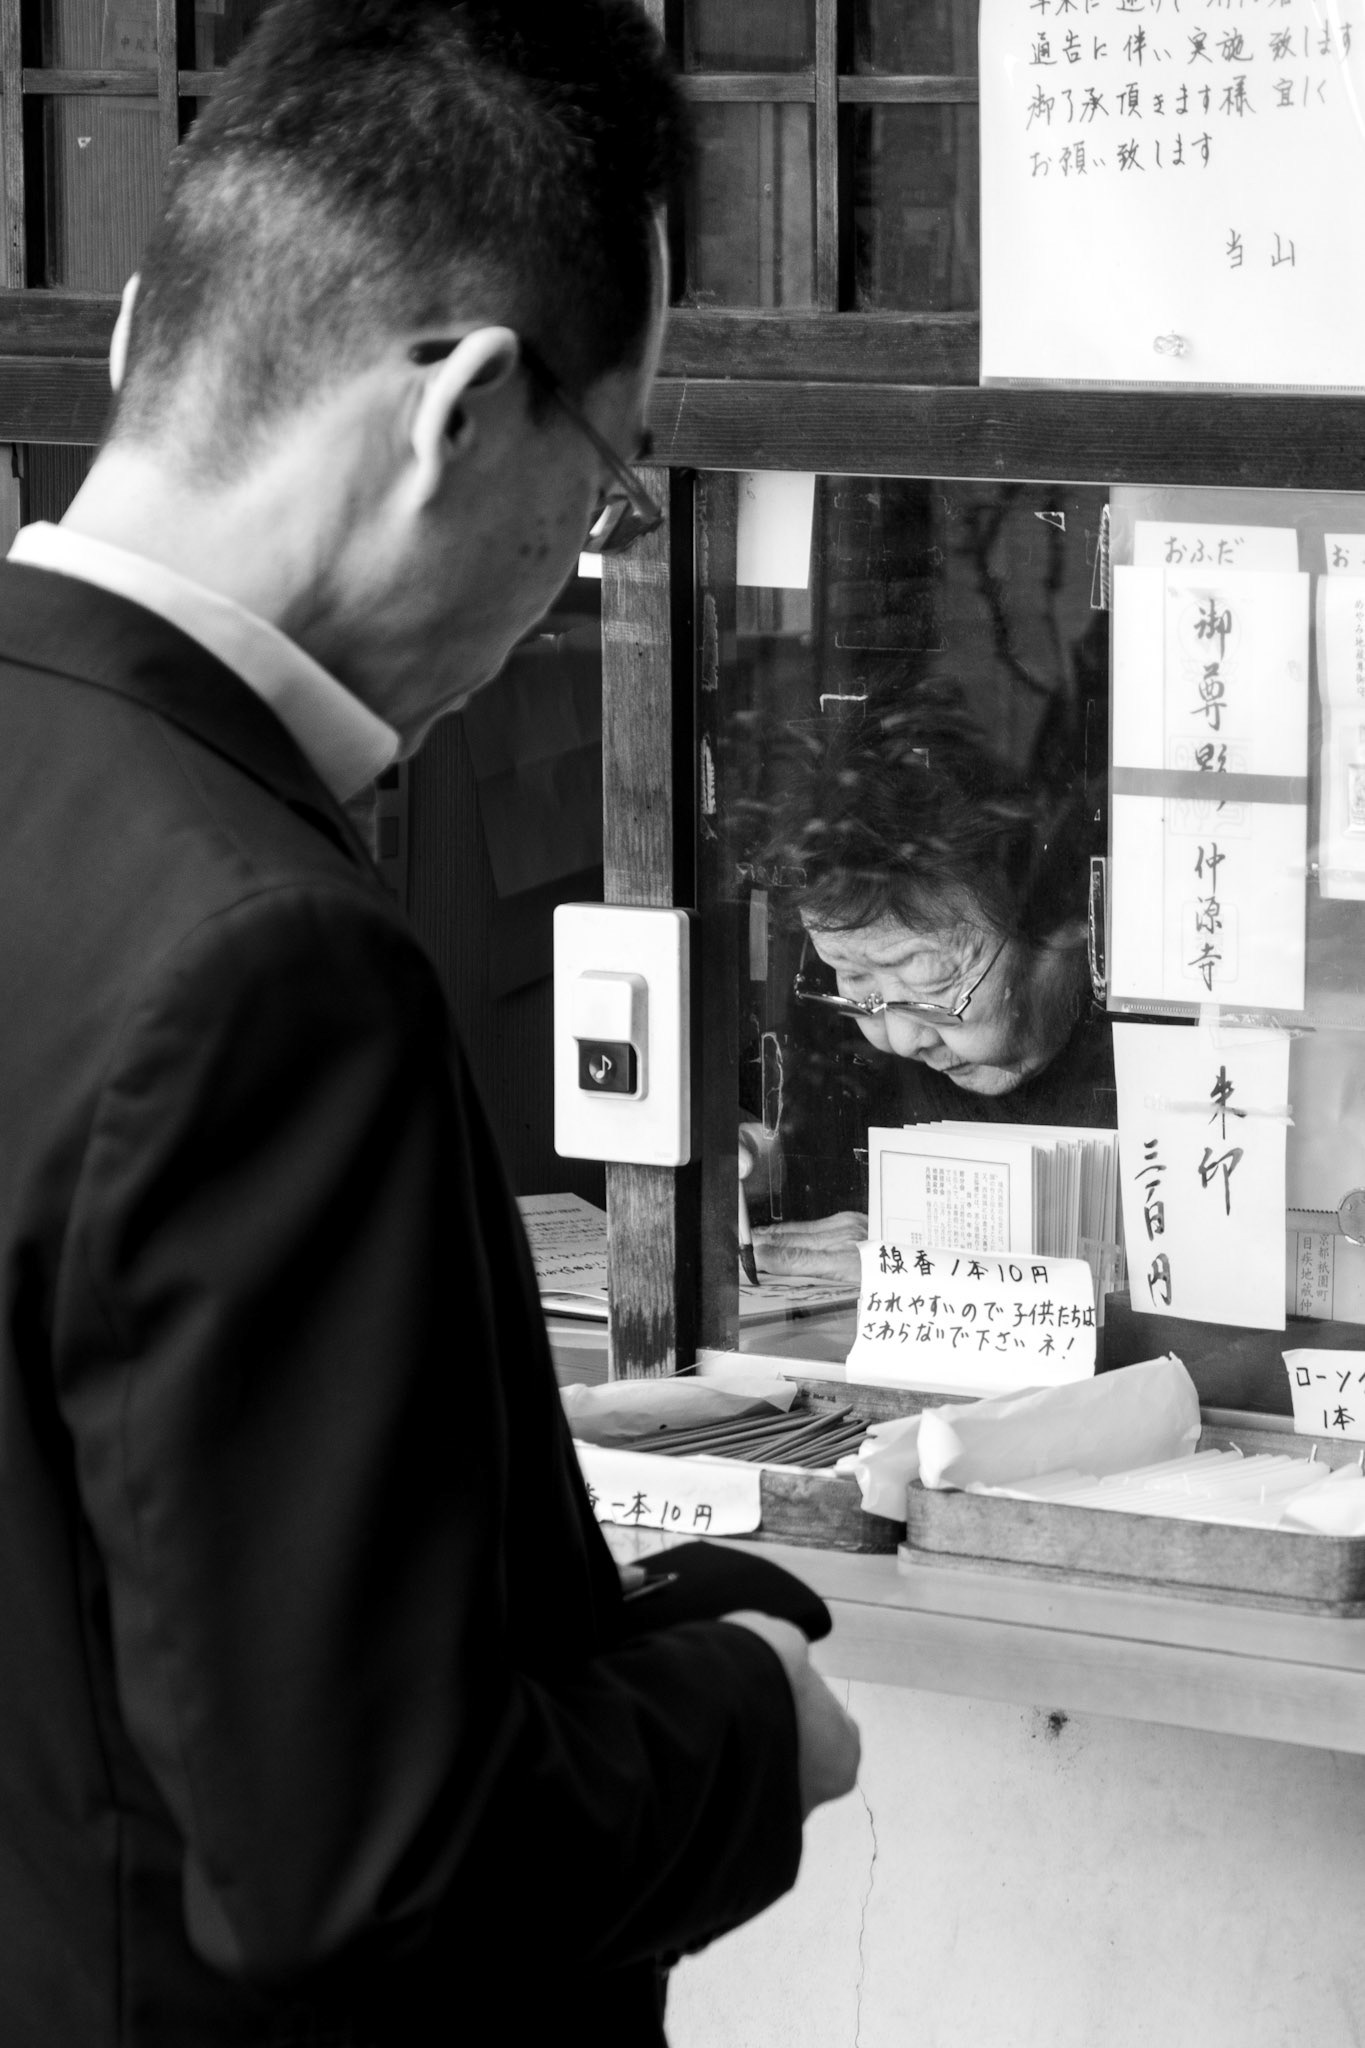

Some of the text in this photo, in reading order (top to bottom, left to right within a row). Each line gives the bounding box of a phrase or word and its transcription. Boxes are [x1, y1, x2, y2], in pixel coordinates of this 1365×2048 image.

[1030, 131, 1213, 177] お願い致します
[1164, 536, 1245, 565] おふだ
[1332, 544, 1365, 568] お
[1198, 1065, 1247, 1217] 朱印
[1134, 1138, 1172, 1308] 三百円
[879, 1244, 1049, 1284] 線香1本10円
[867, 1291, 1096, 1329] おれやすいので子供たちは
